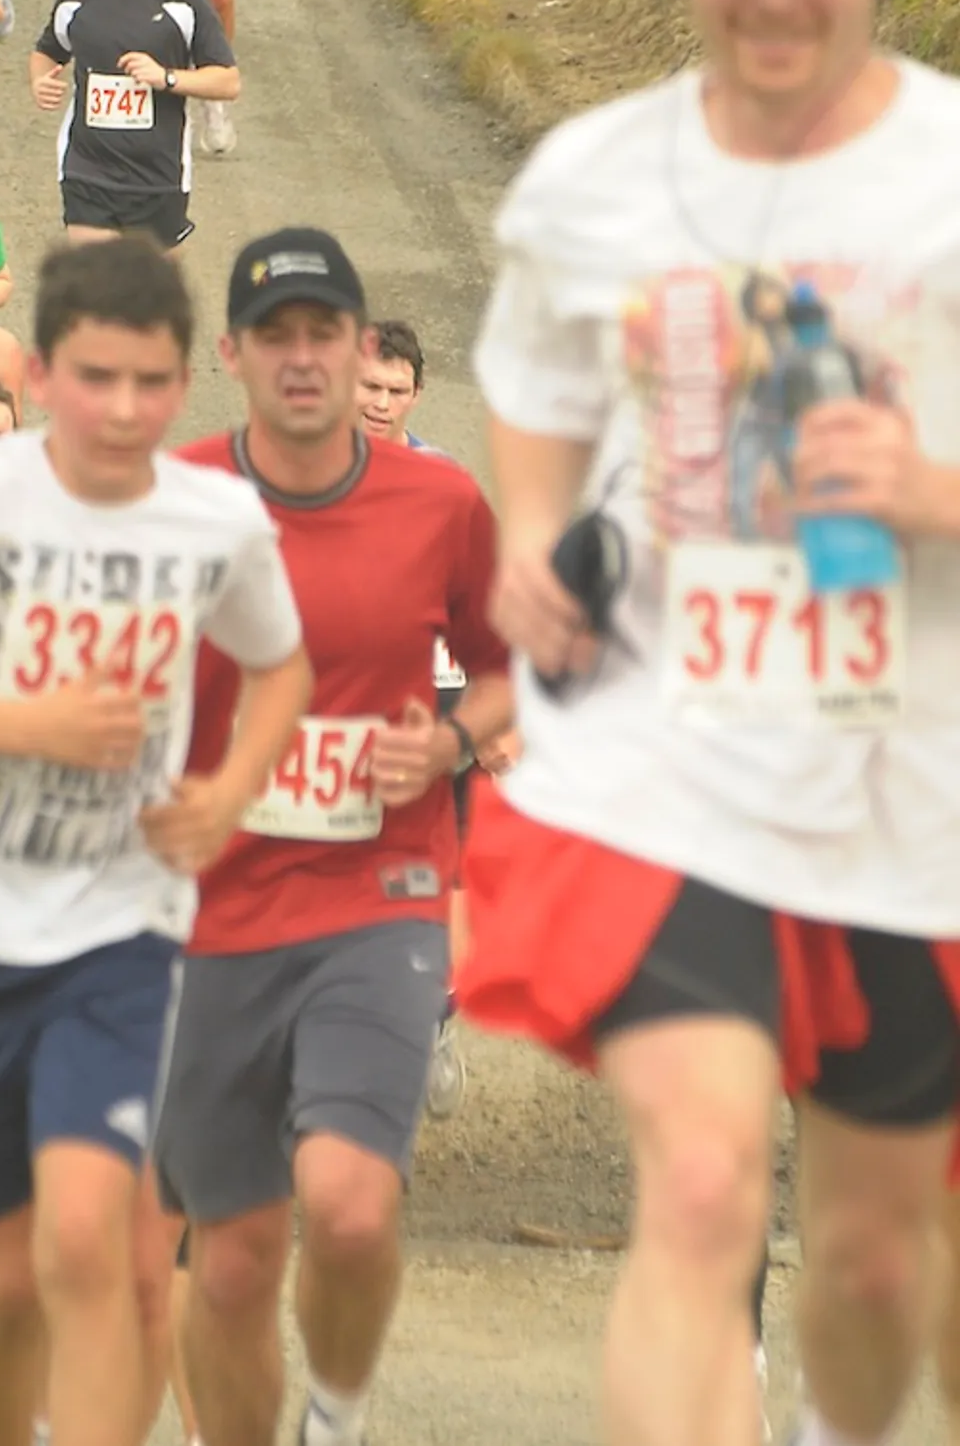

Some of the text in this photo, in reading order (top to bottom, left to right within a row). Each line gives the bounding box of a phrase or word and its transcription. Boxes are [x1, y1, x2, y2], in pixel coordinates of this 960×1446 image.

[91, 87, 148, 116] 3747
[682, 587, 892, 684] 3713
[254, 726, 376, 810] 454
